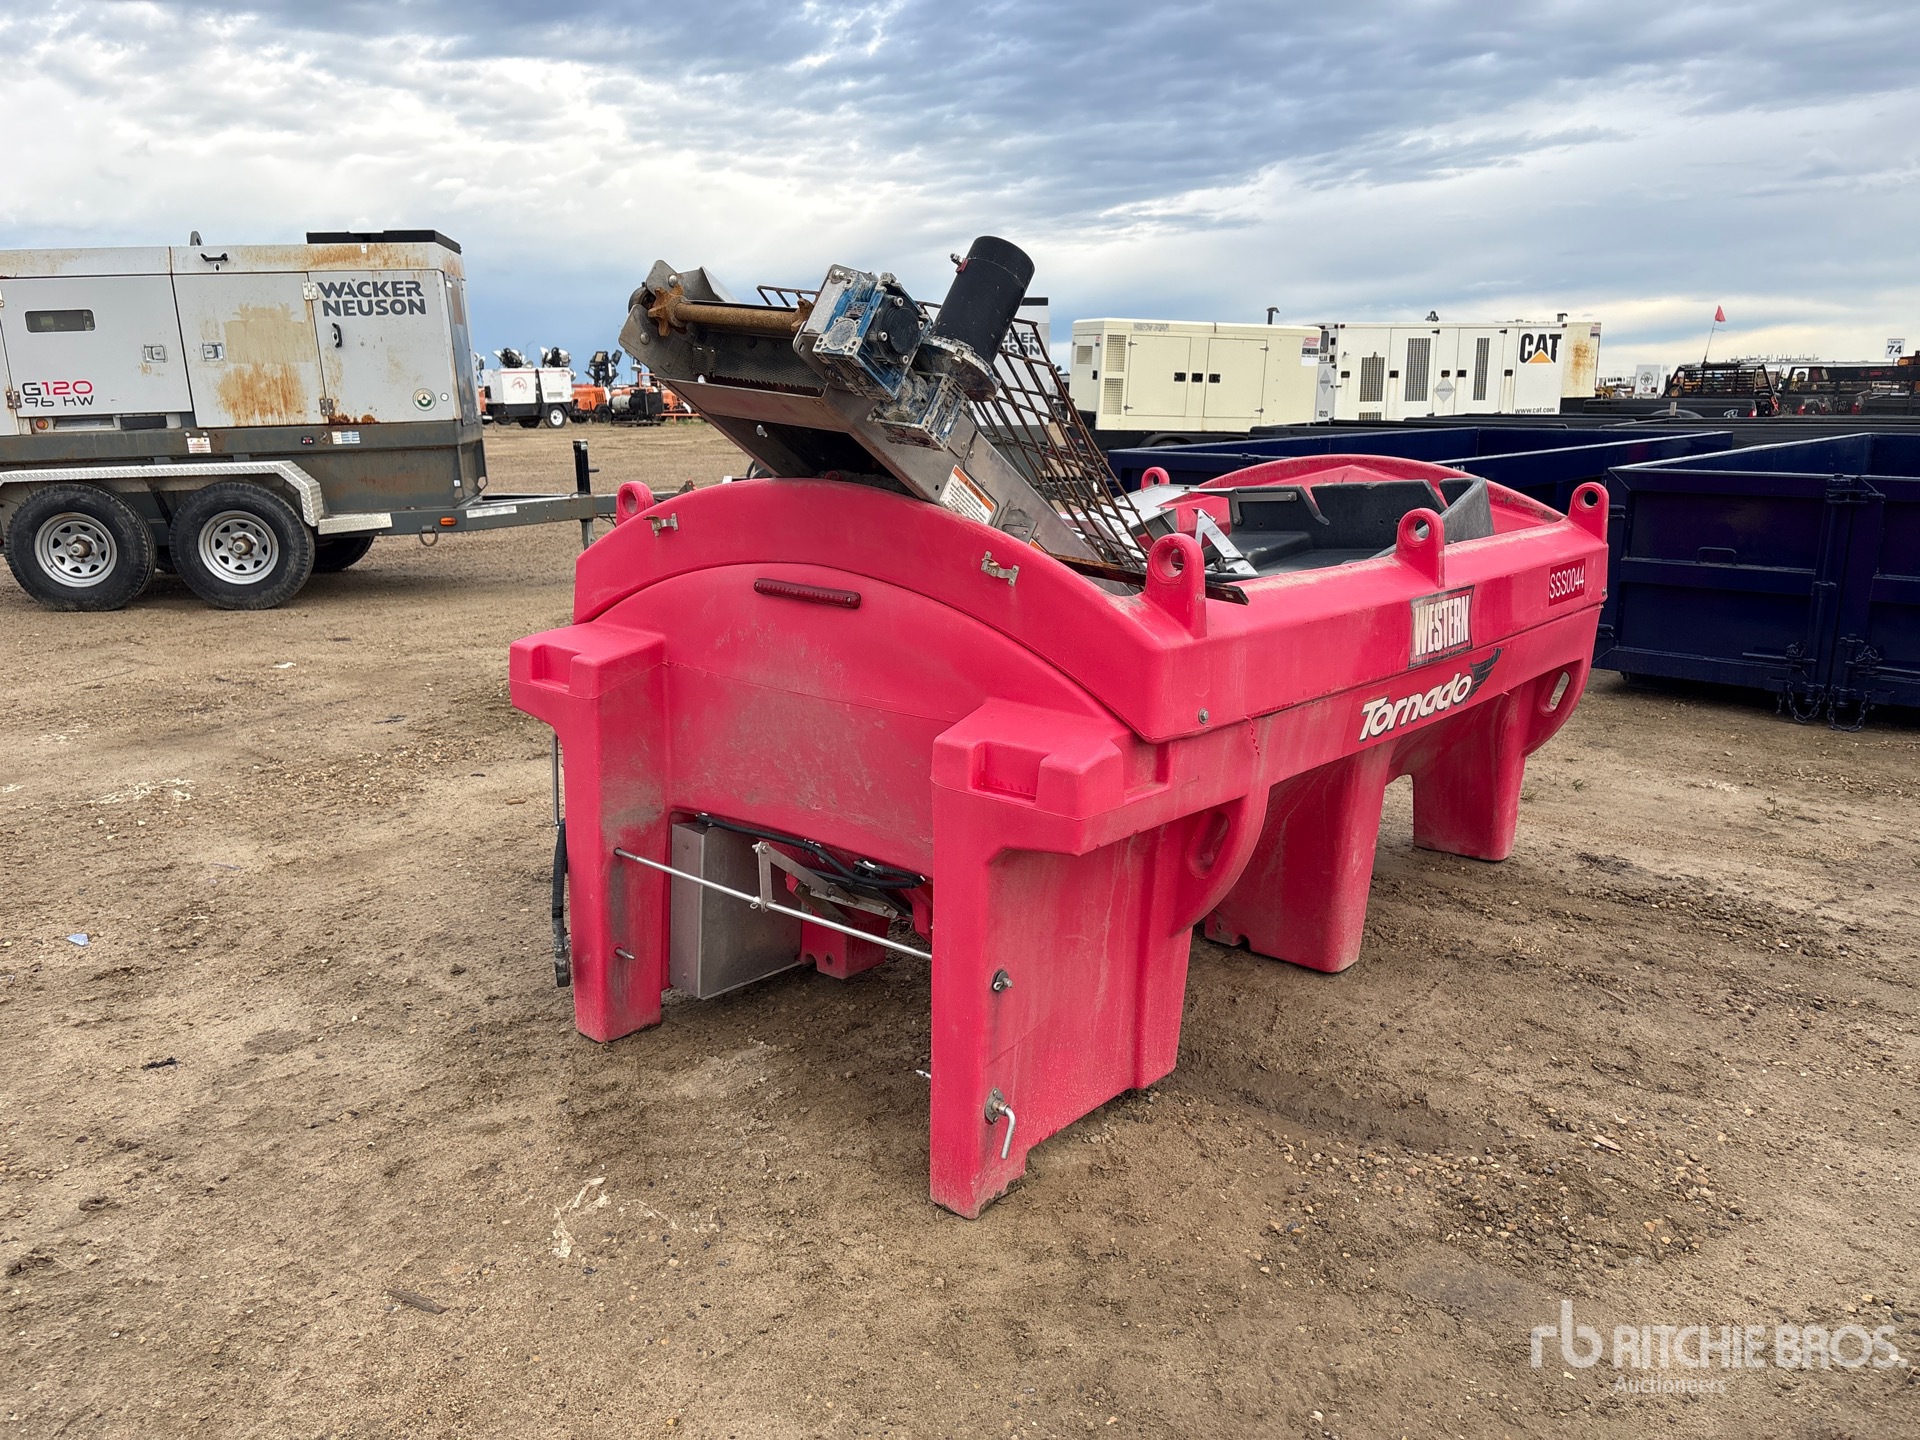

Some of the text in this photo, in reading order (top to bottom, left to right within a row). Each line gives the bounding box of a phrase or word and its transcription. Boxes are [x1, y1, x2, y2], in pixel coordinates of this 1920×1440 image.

[317, 280, 424, 298] WACKER
[322, 298, 427, 317] NEUSON
[1519, 333, 1562, 363] CAT
[1887, 345, 1902, 355] 74
[22, 380, 93, 396] G120
[24, 397, 55, 408] 96
[1515, 406, 1556, 414] www.cat.com
[1549, 564, 1585, 600] SSS0044
[1415, 594, 1470, 656] WESTERN
[1358, 672, 1473, 742] Tornado
